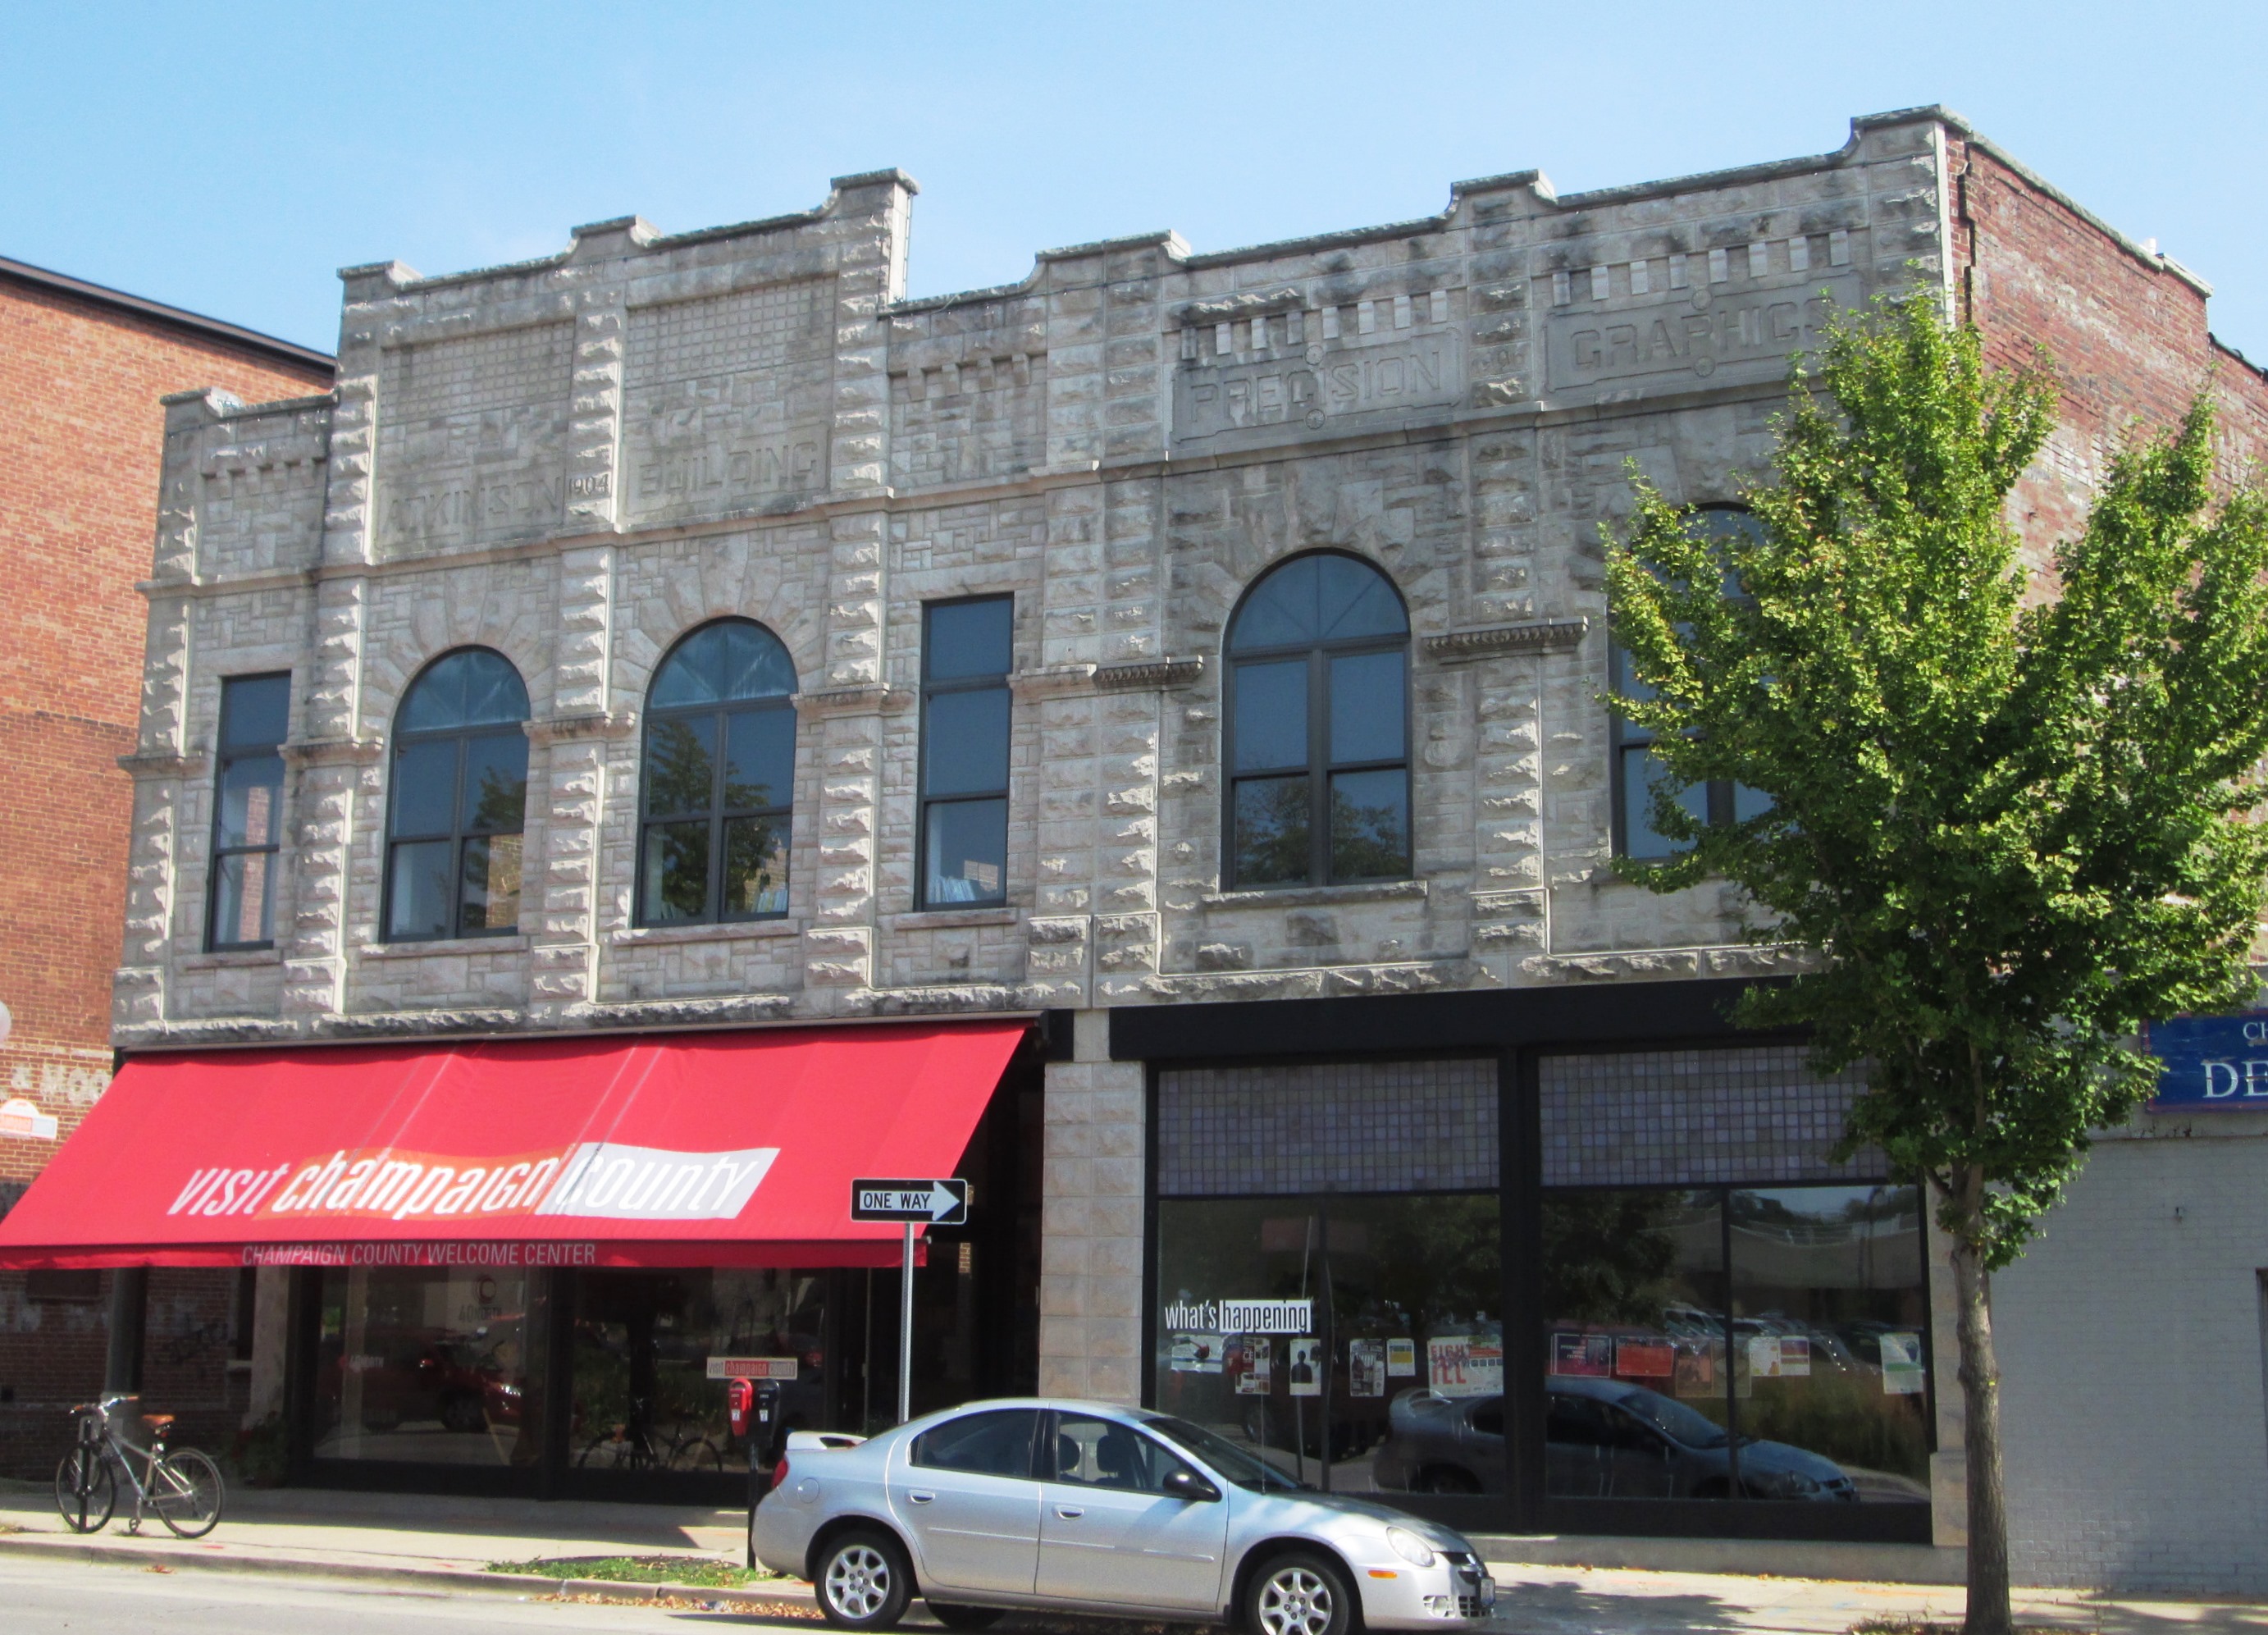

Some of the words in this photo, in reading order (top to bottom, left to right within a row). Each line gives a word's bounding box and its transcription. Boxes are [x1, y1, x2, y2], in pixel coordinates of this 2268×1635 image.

[1189, 351, 1441, 422] PRECISION
[568, 473, 609, 498] 1904
[639, 441, 818, 498] BUILDING
[382, 475, 562, 536] ATKINSON
[863, 1192, 892, 1209] ONE
[900, 1192, 931, 1209] WAY
[242, 1245, 346, 1266] CHAMPAIGN
[351, 1244, 423, 1265] COUNTY
[427, 1244, 518, 1264] WELCOME
[524, 1243, 596, 1264] CENTER
[1165, 1299, 1216, 1330] what's
[1222, 1299, 1307, 1332] happening
